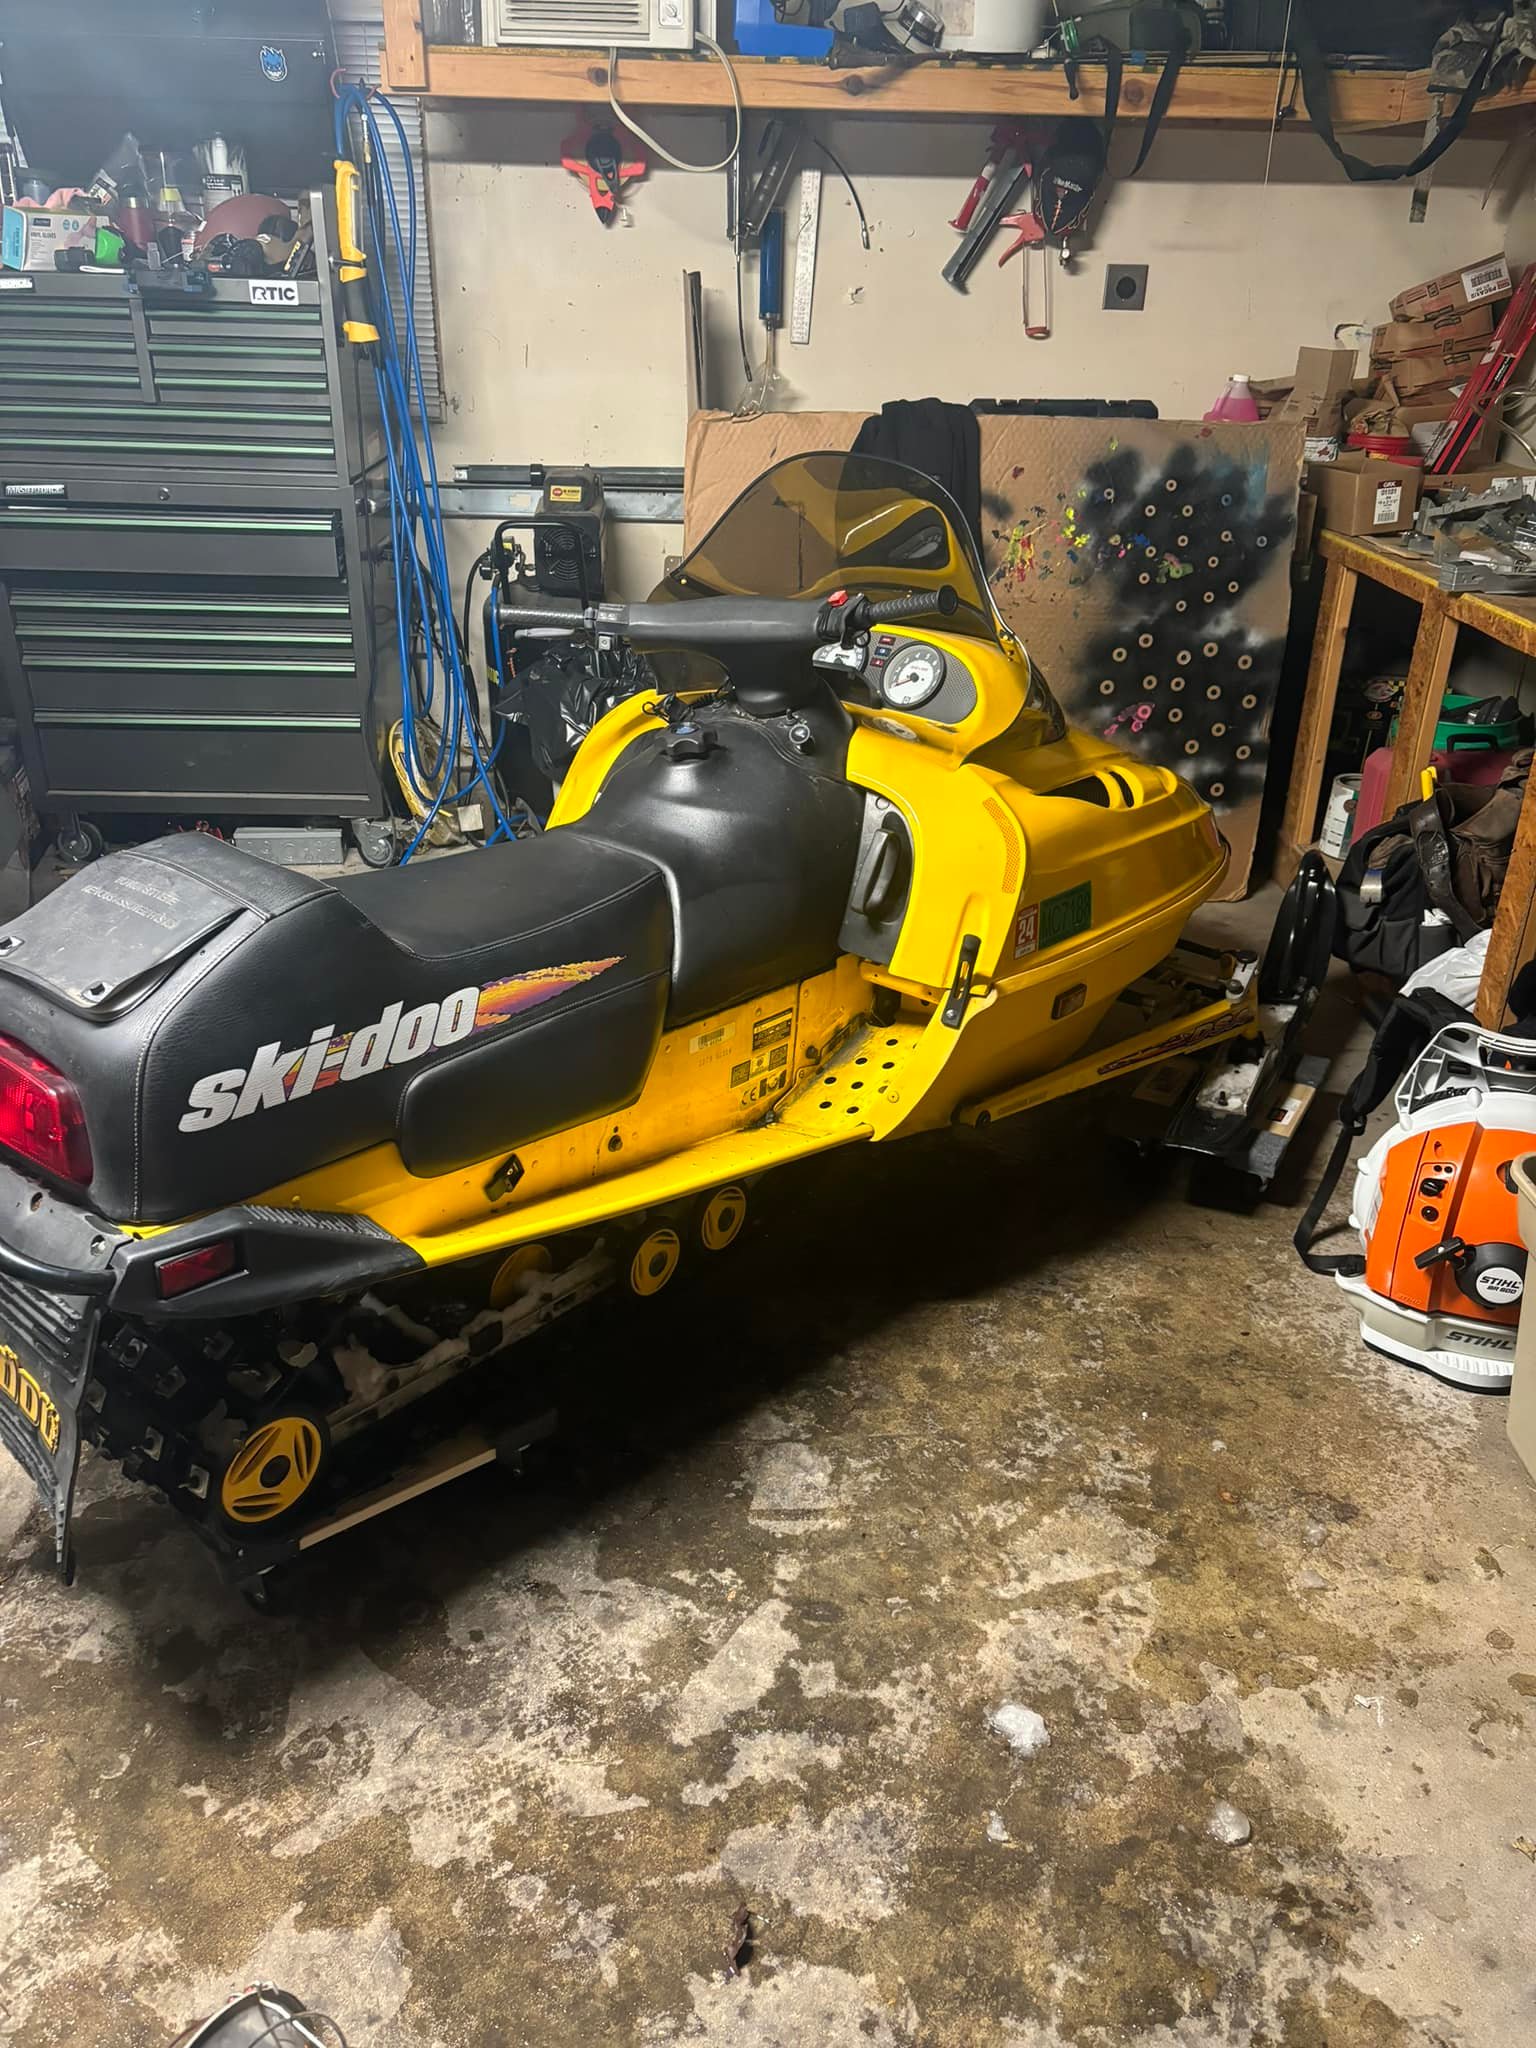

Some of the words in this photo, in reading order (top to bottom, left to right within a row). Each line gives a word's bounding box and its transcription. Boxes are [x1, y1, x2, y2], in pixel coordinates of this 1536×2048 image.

[252, 286, 295, 300] RTIC
[1018, 915, 1034, 945] 24
[178, 986, 480, 1133] ski-doo
[1480, 1276, 1520, 1289] STIHL
[1446, 1331, 1513, 1350] STIHL
